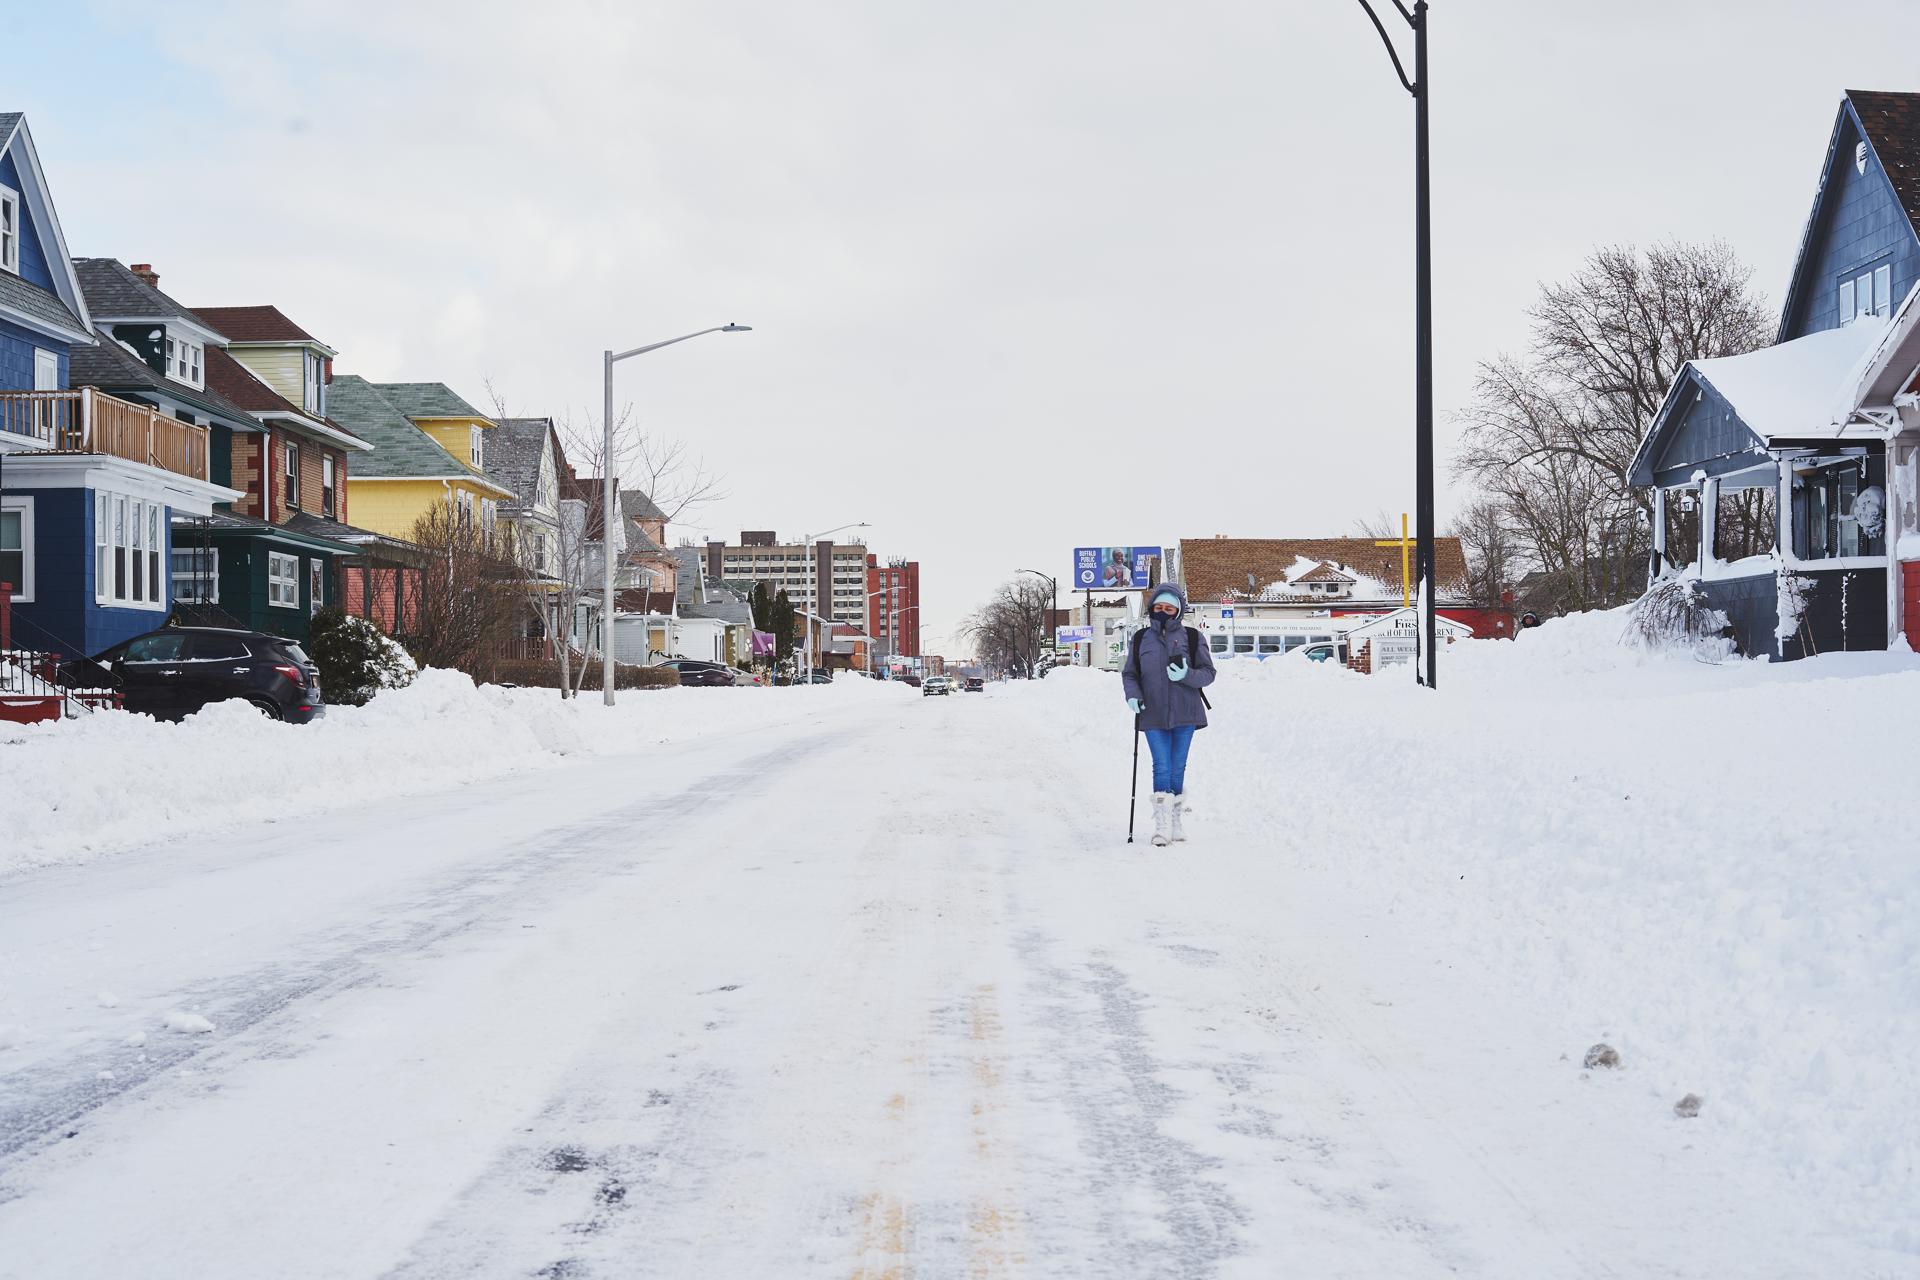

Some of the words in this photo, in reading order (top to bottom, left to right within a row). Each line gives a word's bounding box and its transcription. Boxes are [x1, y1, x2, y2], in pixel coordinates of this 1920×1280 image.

[1395, 619, 1417, 628] FIRS
[1393, 629, 1402, 637] OF
[1404, 629, 1417, 637] THE
